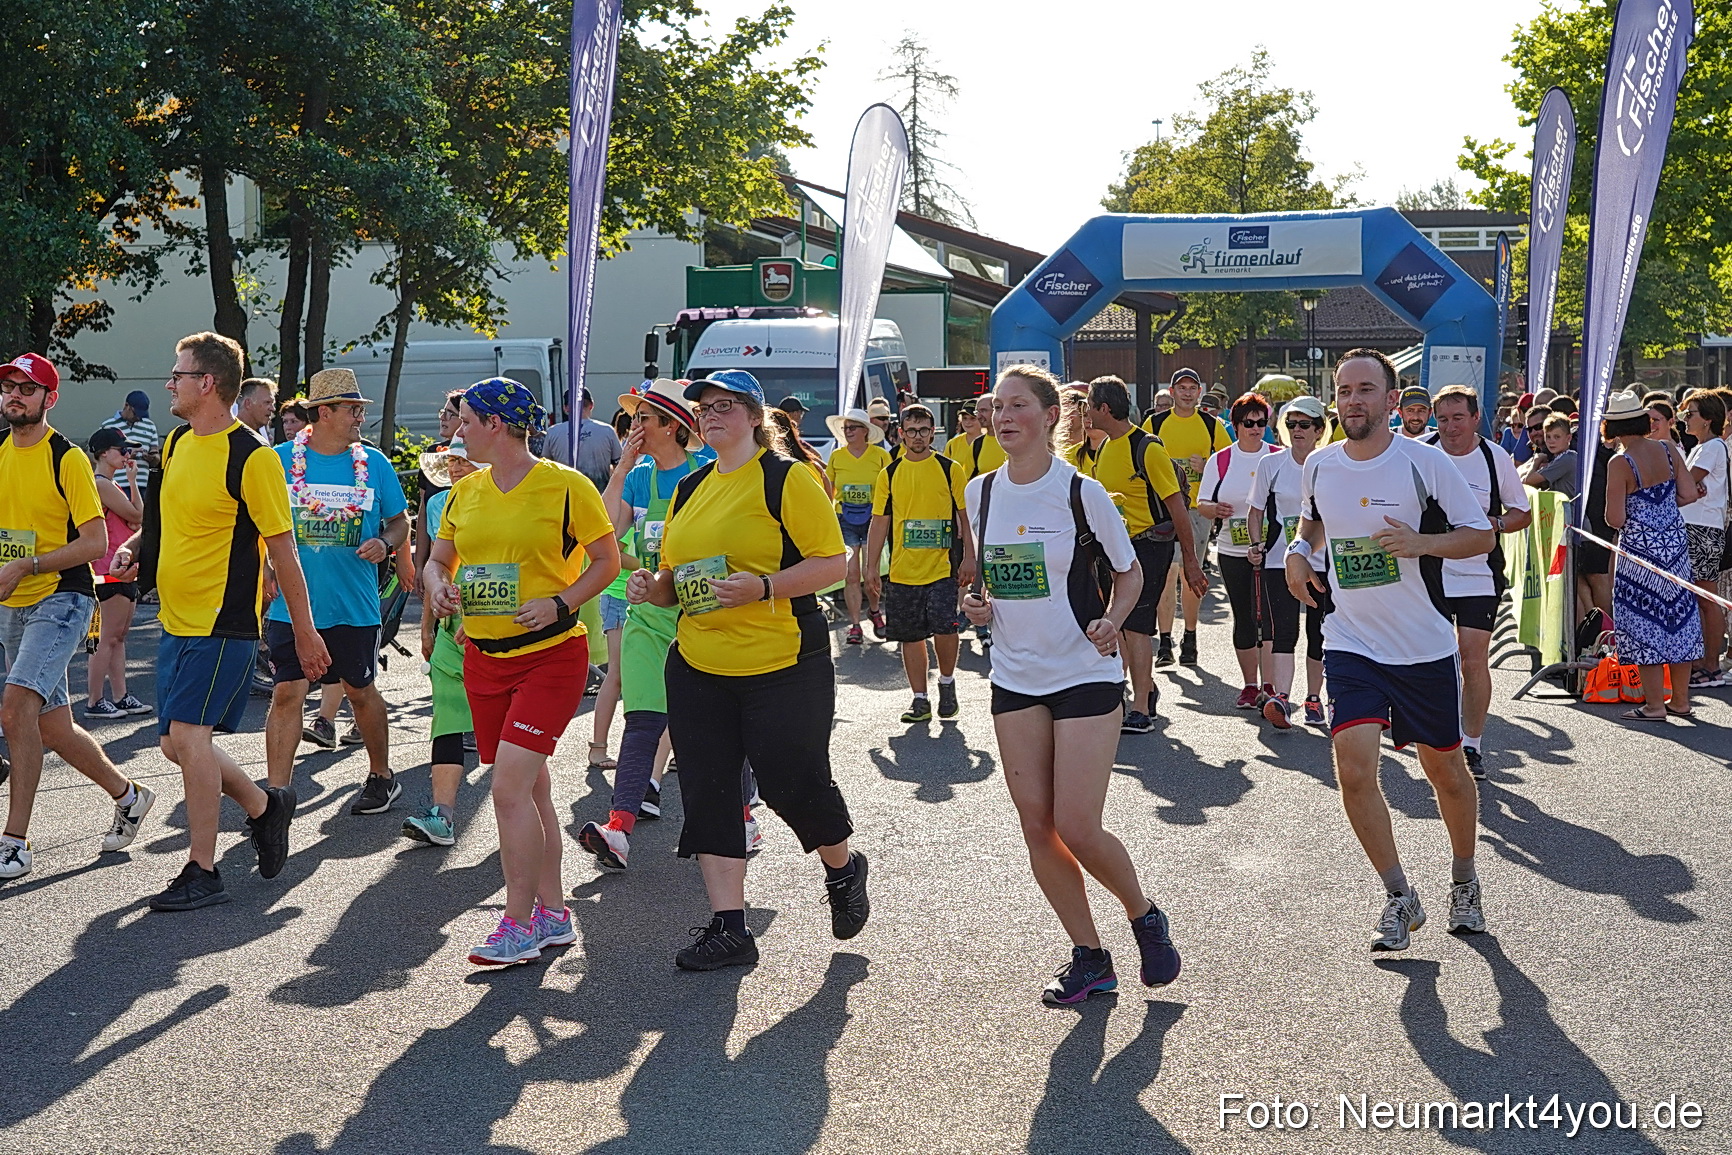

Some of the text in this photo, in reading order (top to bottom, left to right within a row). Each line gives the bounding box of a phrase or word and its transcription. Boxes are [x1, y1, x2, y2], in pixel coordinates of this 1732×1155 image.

[586, 0, 606, 121] Fische
[597, 3, 612, 116] AUTOMOBILE
[1647, 10, 1679, 125] AUTOMOBILE
[1544, 115, 1564, 214] Fischer
[1554, 129, 1568, 209] AUTOMOBILE
[864, 131, 892, 226] Fischer
[878, 146, 898, 220] AUTOMOBILE
[1237, 233, 1267, 241] Fischer
[1215, 248, 1303, 266] firmenlauf
[1044, 281, 1092, 291] Fischer
[1404, 274, 1417, 282] das
[576, 201, 601, 401] www.fischer-automobile.de
[701, 346, 741, 356] abavent
[315, 489, 330, 497] Freie
[846, 491, 867, 499] 1285
[304, 520, 340, 533] 1440
[909, 529, 936, 540] 1255
[1341, 553, 1385, 572] 1323
[1386, 554, 1397, 576] 2022
[984, 570, 992, 588] RUN
[991, 562, 1035, 582] 1325
[1035, 564, 1045, 590] 2022
[1361, 571, 1386, 579] Michael
[468, 581, 509, 599] 1256
[682, 574, 716, 599] 126
[1008, 581, 1038, 590] Stephanie
[513, 720, 545, 736] saller
